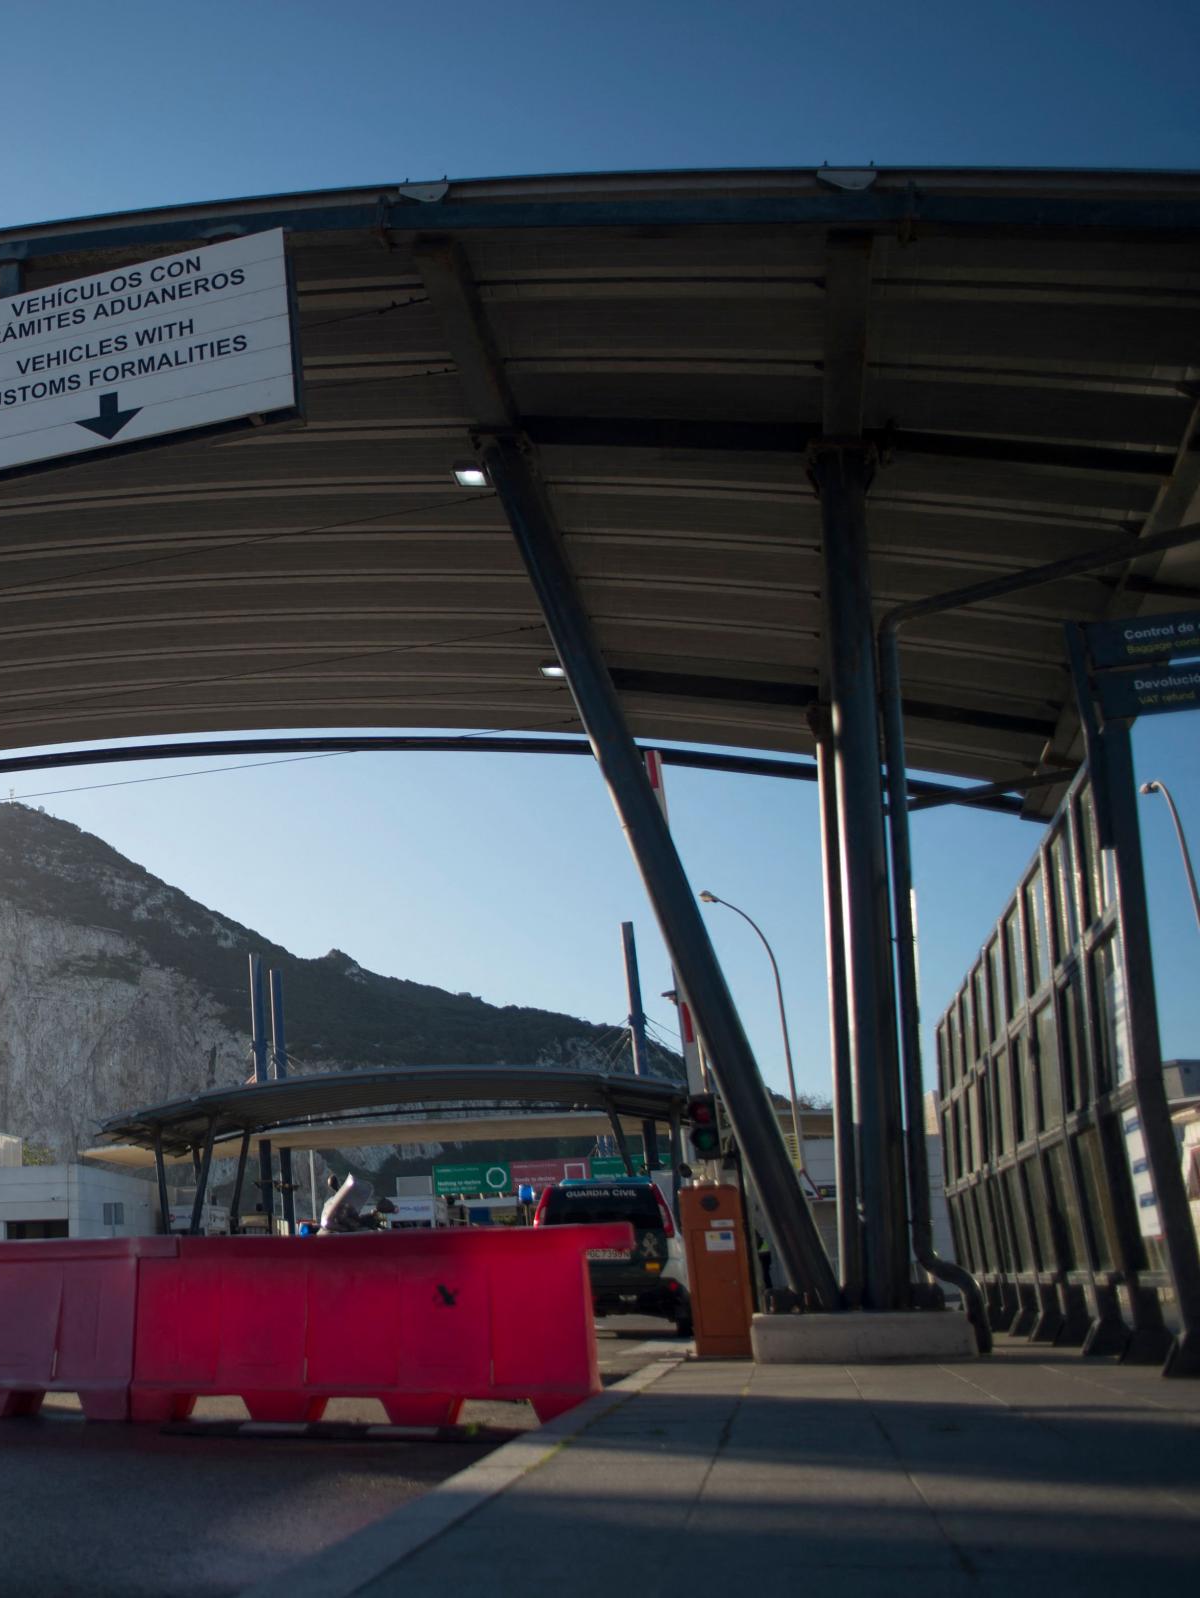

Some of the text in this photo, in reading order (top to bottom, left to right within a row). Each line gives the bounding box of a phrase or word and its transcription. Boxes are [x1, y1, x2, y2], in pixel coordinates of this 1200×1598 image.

[11, 255, 201, 317] VEHÍCULOS CON
[94, 268, 245, 320] ADUANEROS
[16, 318, 194, 375] VEHICLES WITH
[89, 334, 248, 386] FORMALITIES
[1124, 625, 1175, 640] Control
[1178, 623, 1194, 633] de
[1135, 674, 1200, 690] Devolució
[1138, 694, 1159, 705] VAT
[565, 1188, 638, 1198] GUARDIA CIVIL
